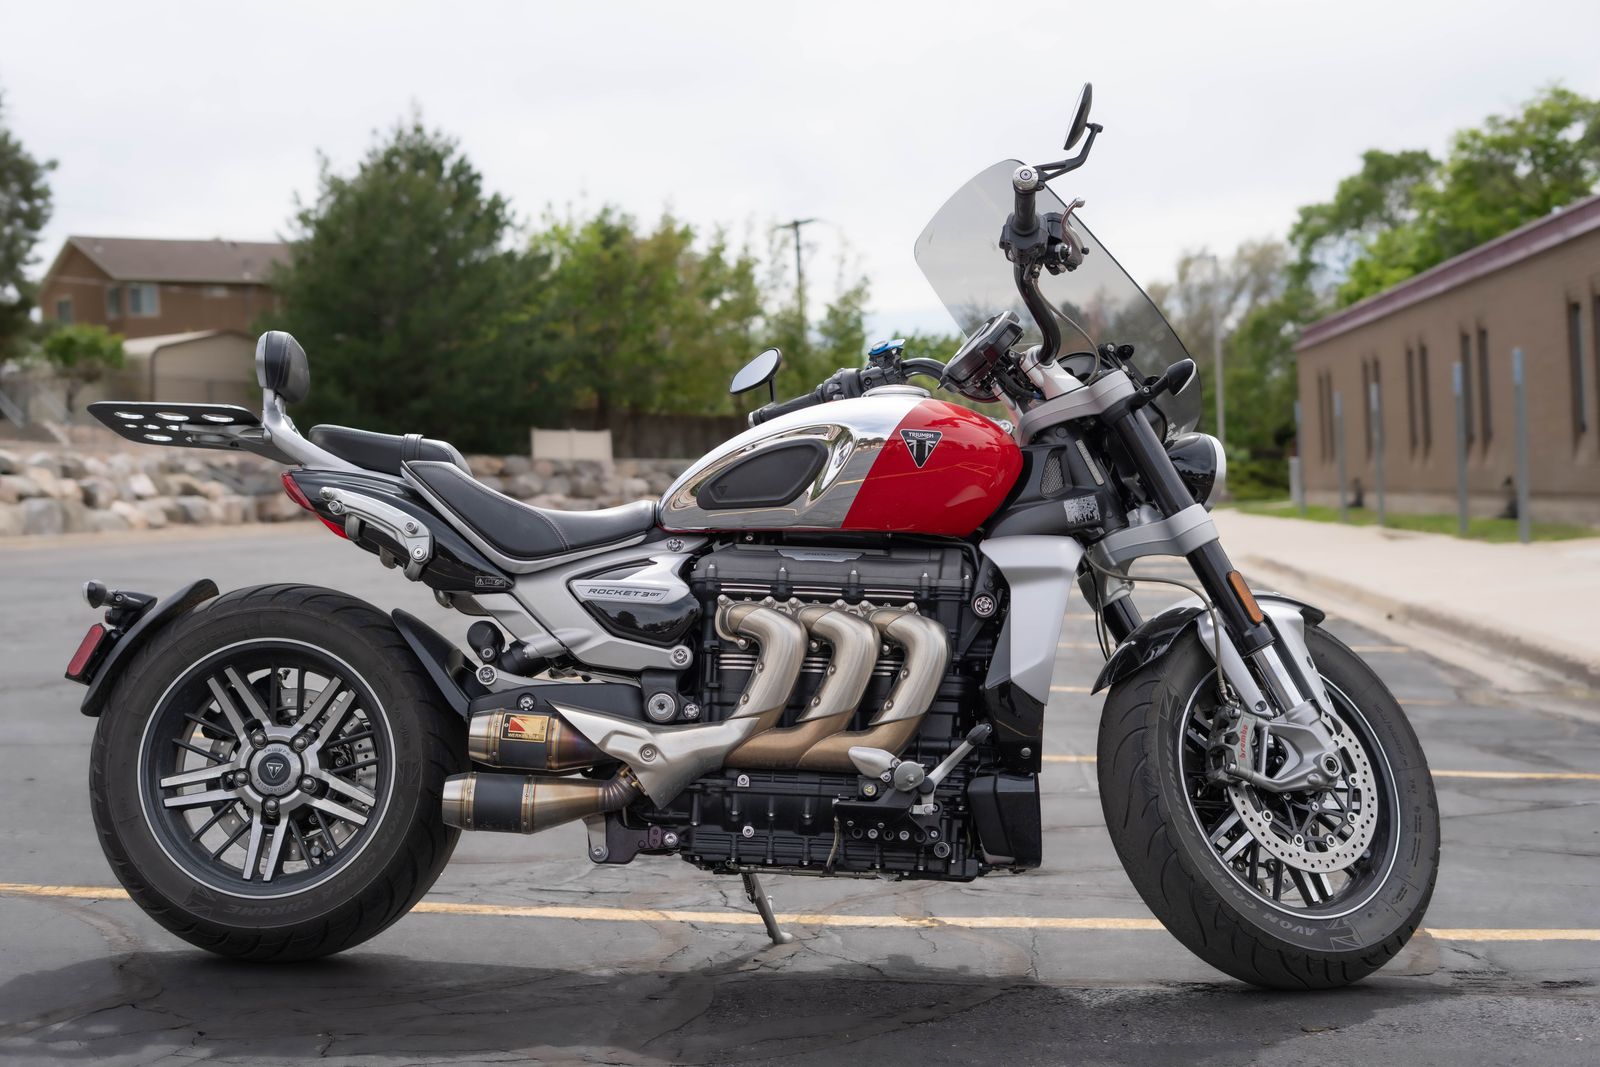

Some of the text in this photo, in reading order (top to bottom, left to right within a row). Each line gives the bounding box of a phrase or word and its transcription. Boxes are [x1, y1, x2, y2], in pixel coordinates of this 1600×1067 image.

[908, 431, 935, 439] TRIUMPH
[1240, 724, 1248, 760] brembo
[222, 898, 313, 916] CHROME
[1263, 912, 1318, 936] AVON
